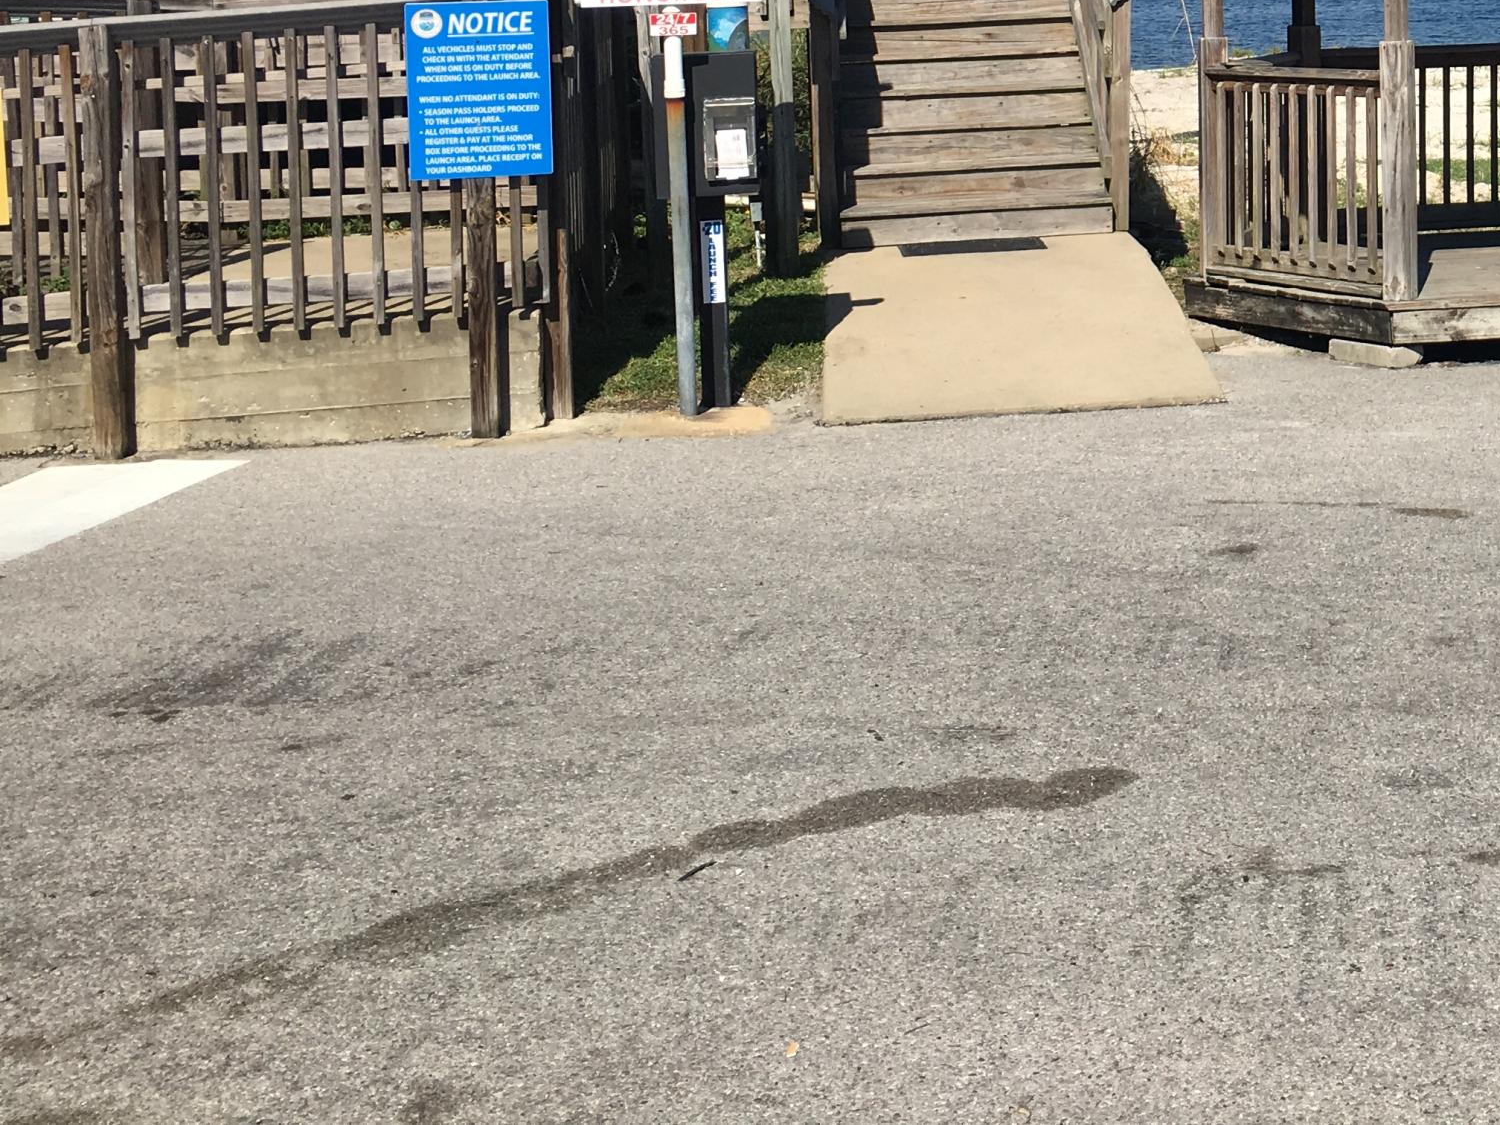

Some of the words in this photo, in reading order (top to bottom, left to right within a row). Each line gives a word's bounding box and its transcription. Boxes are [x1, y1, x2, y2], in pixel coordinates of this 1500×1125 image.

[447, 11, 533, 34] NOTICE
[656, 13, 690, 25] 24/7
[659, 25, 688, 35] 365
[422, 46, 436, 54] ALL
[476, 44, 496, 52] MUST
[498, 43, 516, 51] STOP
[517, 43, 533, 51] AND
[422, 55, 446, 63] CHECK
[447, 55, 455, 63] IN
[476, 54, 490, 62] THE
[491, 53, 534, 61] ATTENDANT
[484, 63, 504, 71] DUTY
[416, 75, 462, 83] PROCEEDING
[419, 96, 441, 104] WHEN
[455, 94, 496, 102] ATTENDANT
[519, 92, 540, 100] DUTY:
[424, 108, 452, 116] SEASON
[454, 107, 472, 115] PASS
[473, 106, 505, 114] HOLDERS
[436, 117, 449, 125] THE
[439, 127, 463, 135] OTHER
[464, 126, 491, 134] GUESTS
[425, 137, 458, 145] REGISTER
[467, 136, 480, 144] PAY
[442, 146, 468, 155] BEFORE
[470, 145, 515, 153] PROCEEDING
[426, 157, 455, 165] LAUNCH
[456, 156, 477, 164] AREA.
[502, 154, 530, 162] RECEIPT
[447, 165, 492, 173] DASHBOARD
